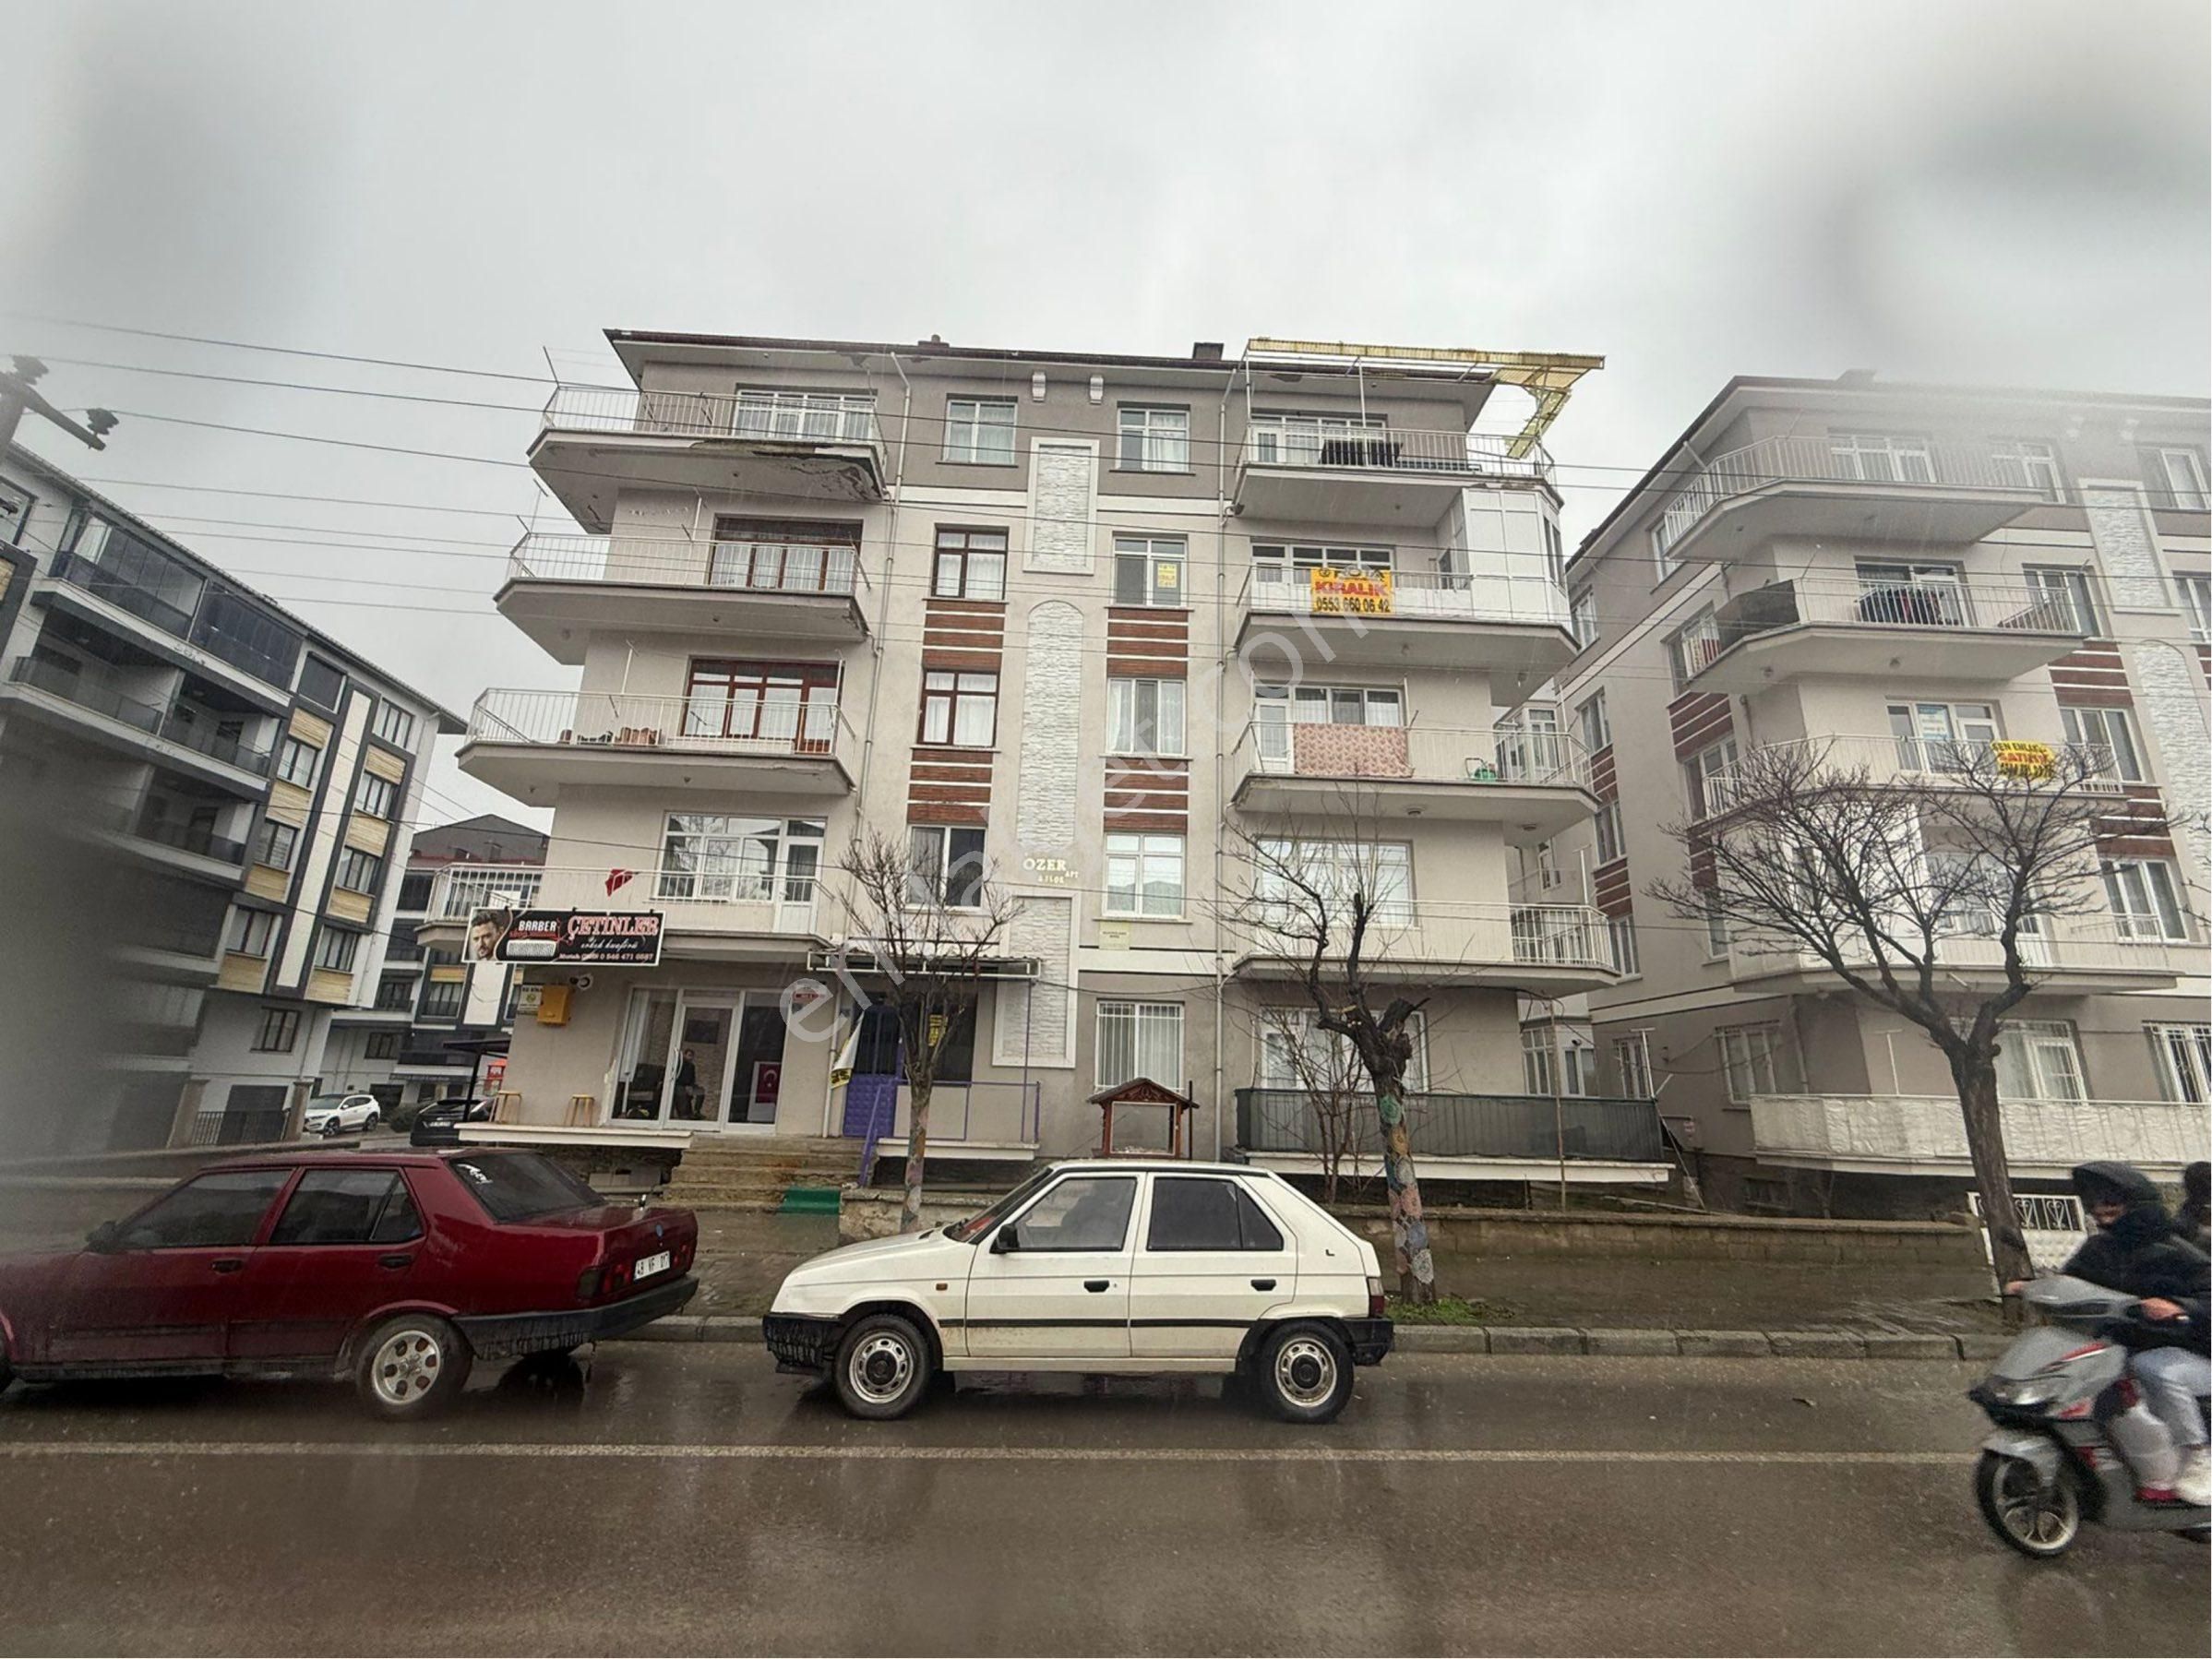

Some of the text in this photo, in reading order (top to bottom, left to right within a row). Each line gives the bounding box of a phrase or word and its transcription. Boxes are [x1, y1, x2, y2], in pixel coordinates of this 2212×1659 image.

[1315, 581, 1389, 596] KIRALIK
[1316, 597, 1339, 611] 0553
[1363, 598, 1376, 612] 06
[1378, 599, 1390, 613] 42
[519, 920, 557, 931] BARBER
[1325, 1248, 1335, 1257] L
